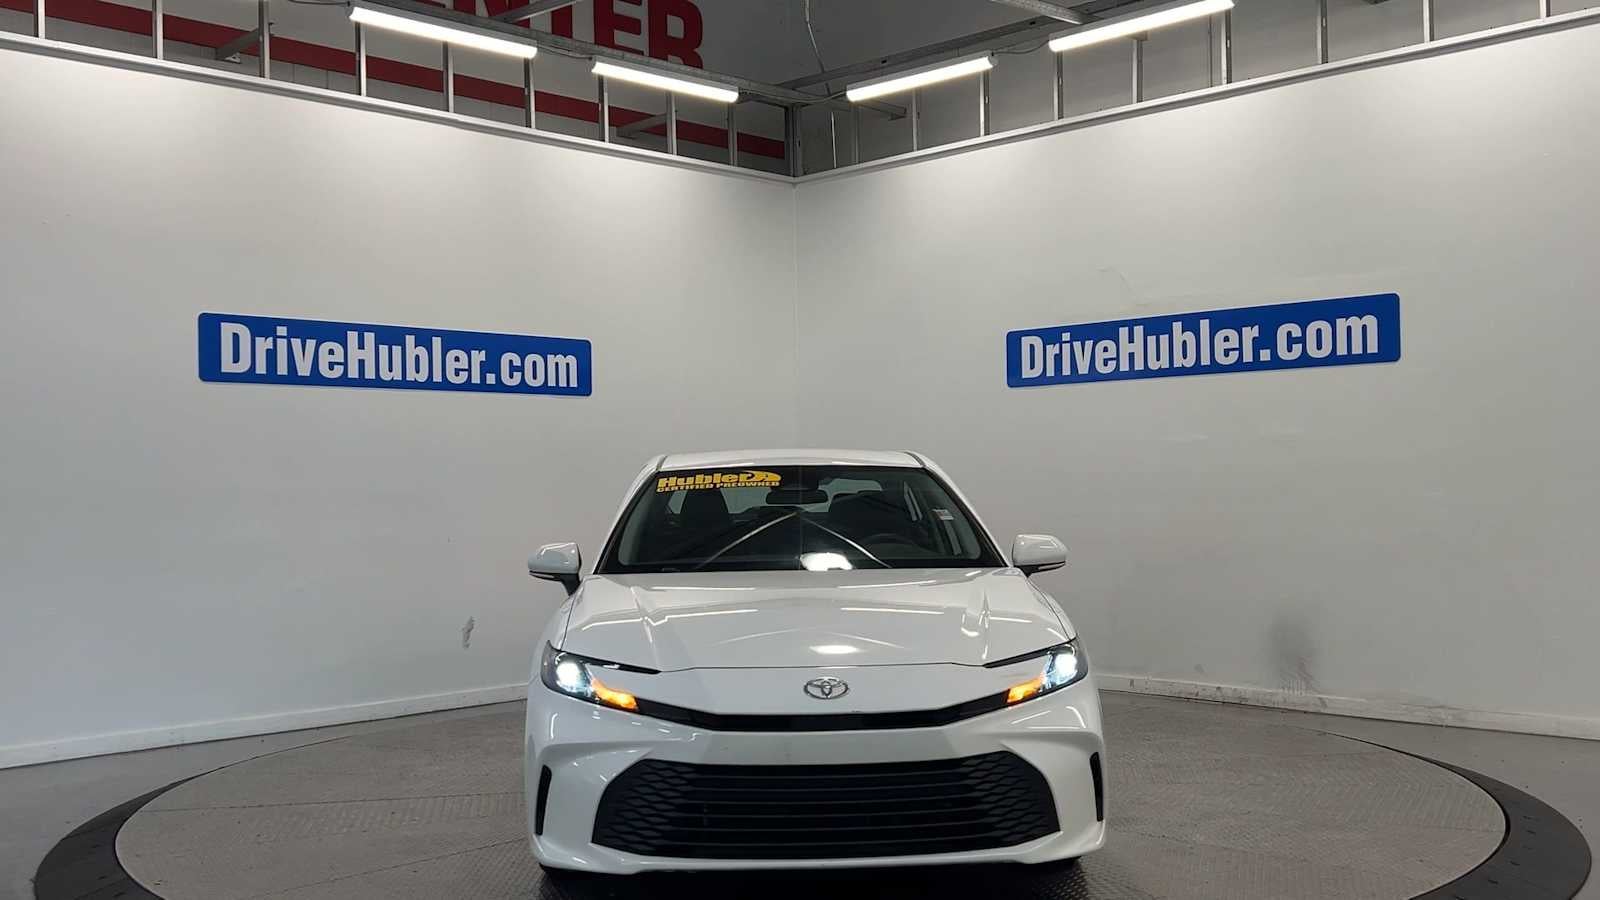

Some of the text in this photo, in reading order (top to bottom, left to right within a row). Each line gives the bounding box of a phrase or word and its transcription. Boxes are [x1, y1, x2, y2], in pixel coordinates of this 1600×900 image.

[219, 321, 579, 388] DriveHubler.com
[1020, 313, 1379, 379] DriveHubler.com
[656, 484, 714, 493] CERTIFIED
[657, 471, 762, 488] Hubler
